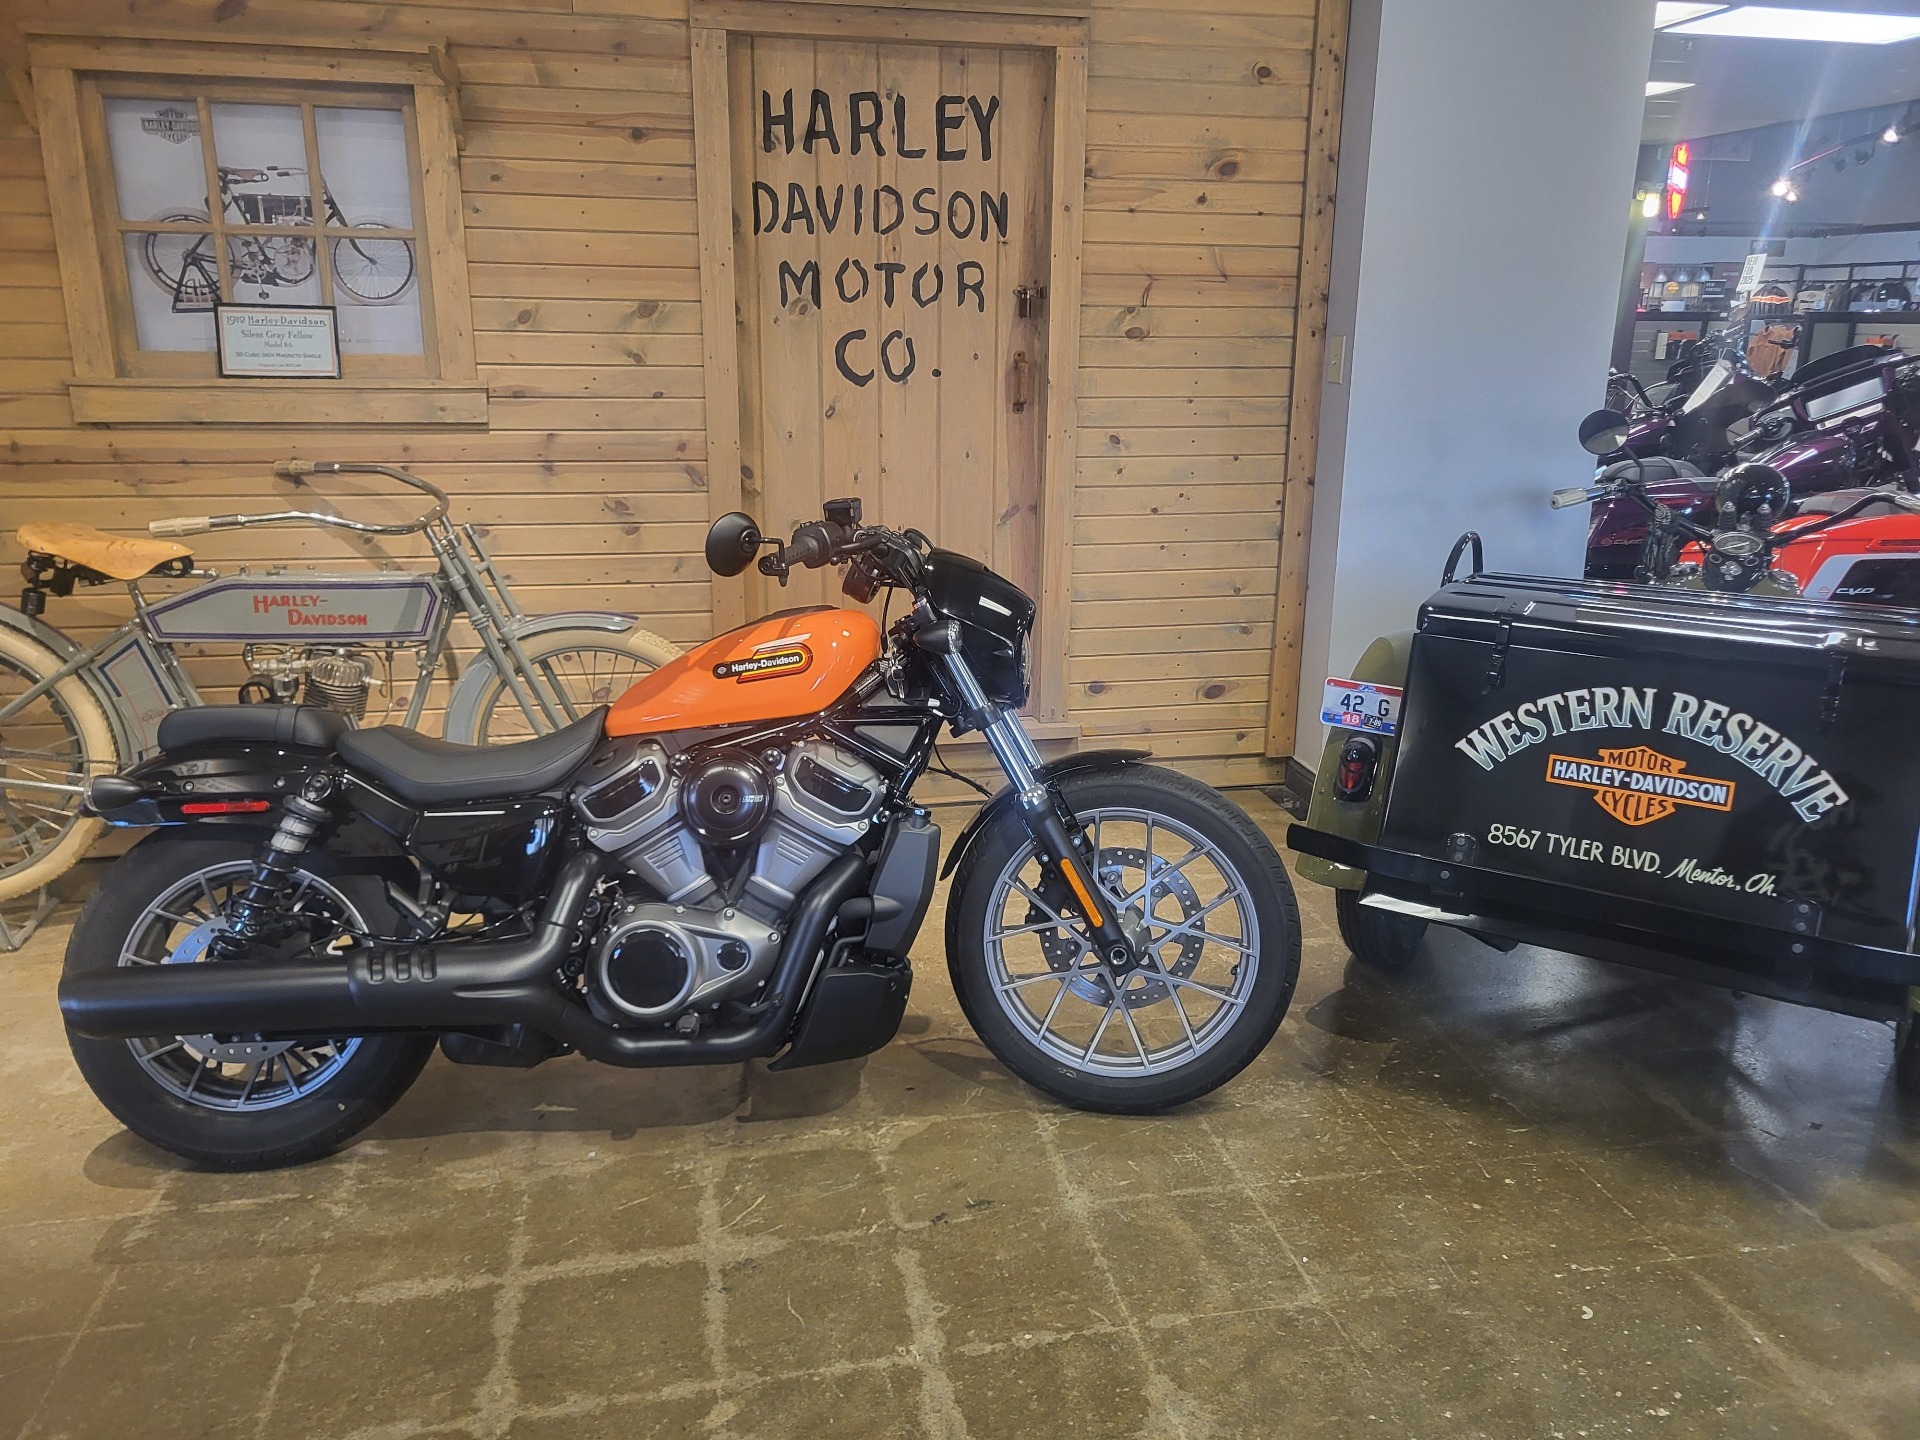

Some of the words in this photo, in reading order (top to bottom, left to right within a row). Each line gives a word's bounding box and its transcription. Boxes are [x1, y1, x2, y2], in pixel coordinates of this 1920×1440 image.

[762, 88, 1000, 162] HARLEY
[752, 181, 1009, 242] DAVIDSON
[779, 258, 985, 312] MOTOR
[241, 330, 264, 338] Silent
[265, 331, 286, 340] Gray
[288, 331, 313, 339] Fellow
[835, 329, 942, 388] CO.
[253, 595, 329, 613] HARLEY-
[288, 608, 367, 625] DAVIDSON
[732, 655, 800, 672] Harley-Davidson
[1340, 693, 1365, 713] 42
[1378, 698, 1390, 717] G
[1345, 713, 1360, 724] 18
[1454, 686, 1658, 771] WESTERN
[1662, 691, 1849, 823] RESERVE
[1608, 749, 1672, 774] MOTOR
[1553, 761, 1728, 804] HARLEY-DAVIDSON
[1601, 789, 1669, 822] CYCLES
[1487, 823, 1542, 850] 8567
[1546, 832, 1604, 863] TYLER
[1610, 845, 1662, 875] BLVD.
[1663, 858, 1741, 891] Mentor,
[1744, 873, 1778, 897] Oh.
